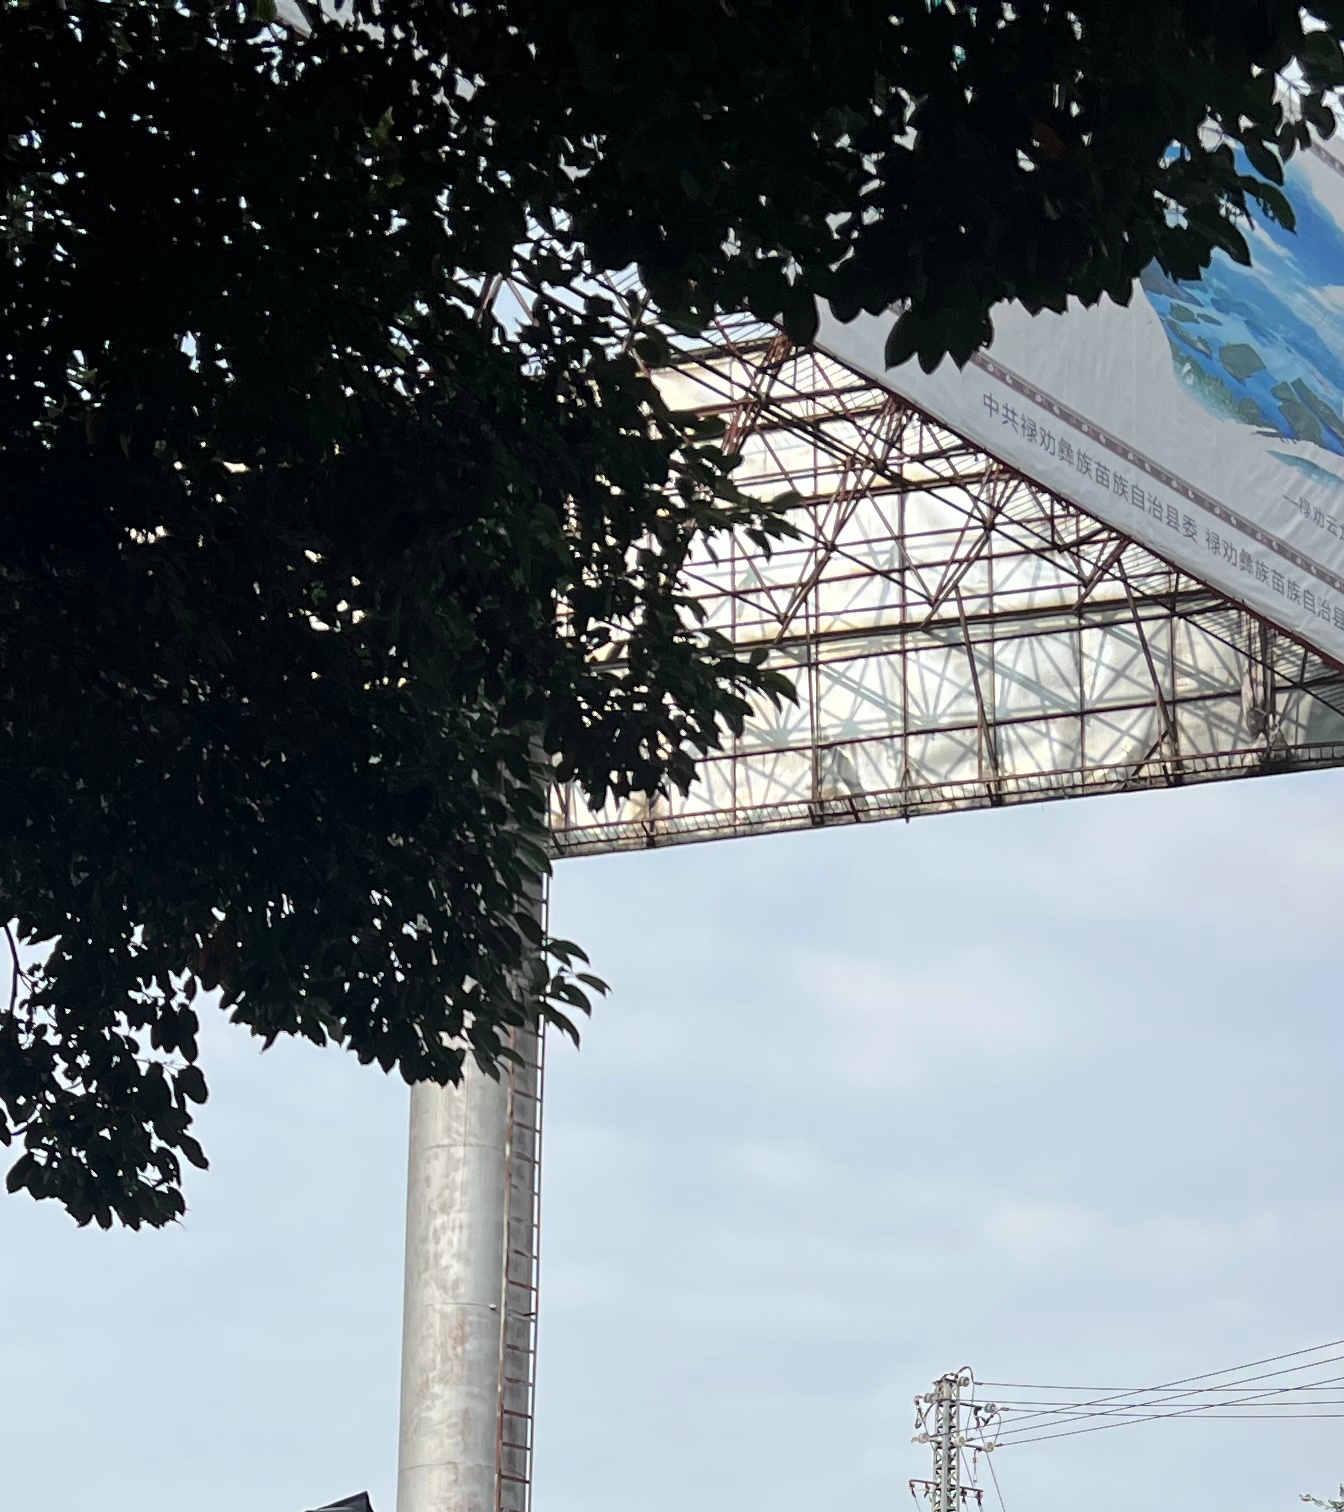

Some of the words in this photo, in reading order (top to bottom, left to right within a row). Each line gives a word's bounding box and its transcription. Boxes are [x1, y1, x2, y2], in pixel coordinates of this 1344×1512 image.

[982, 391, 1199, 545] 中共禄劝彝族苗族自治县委
